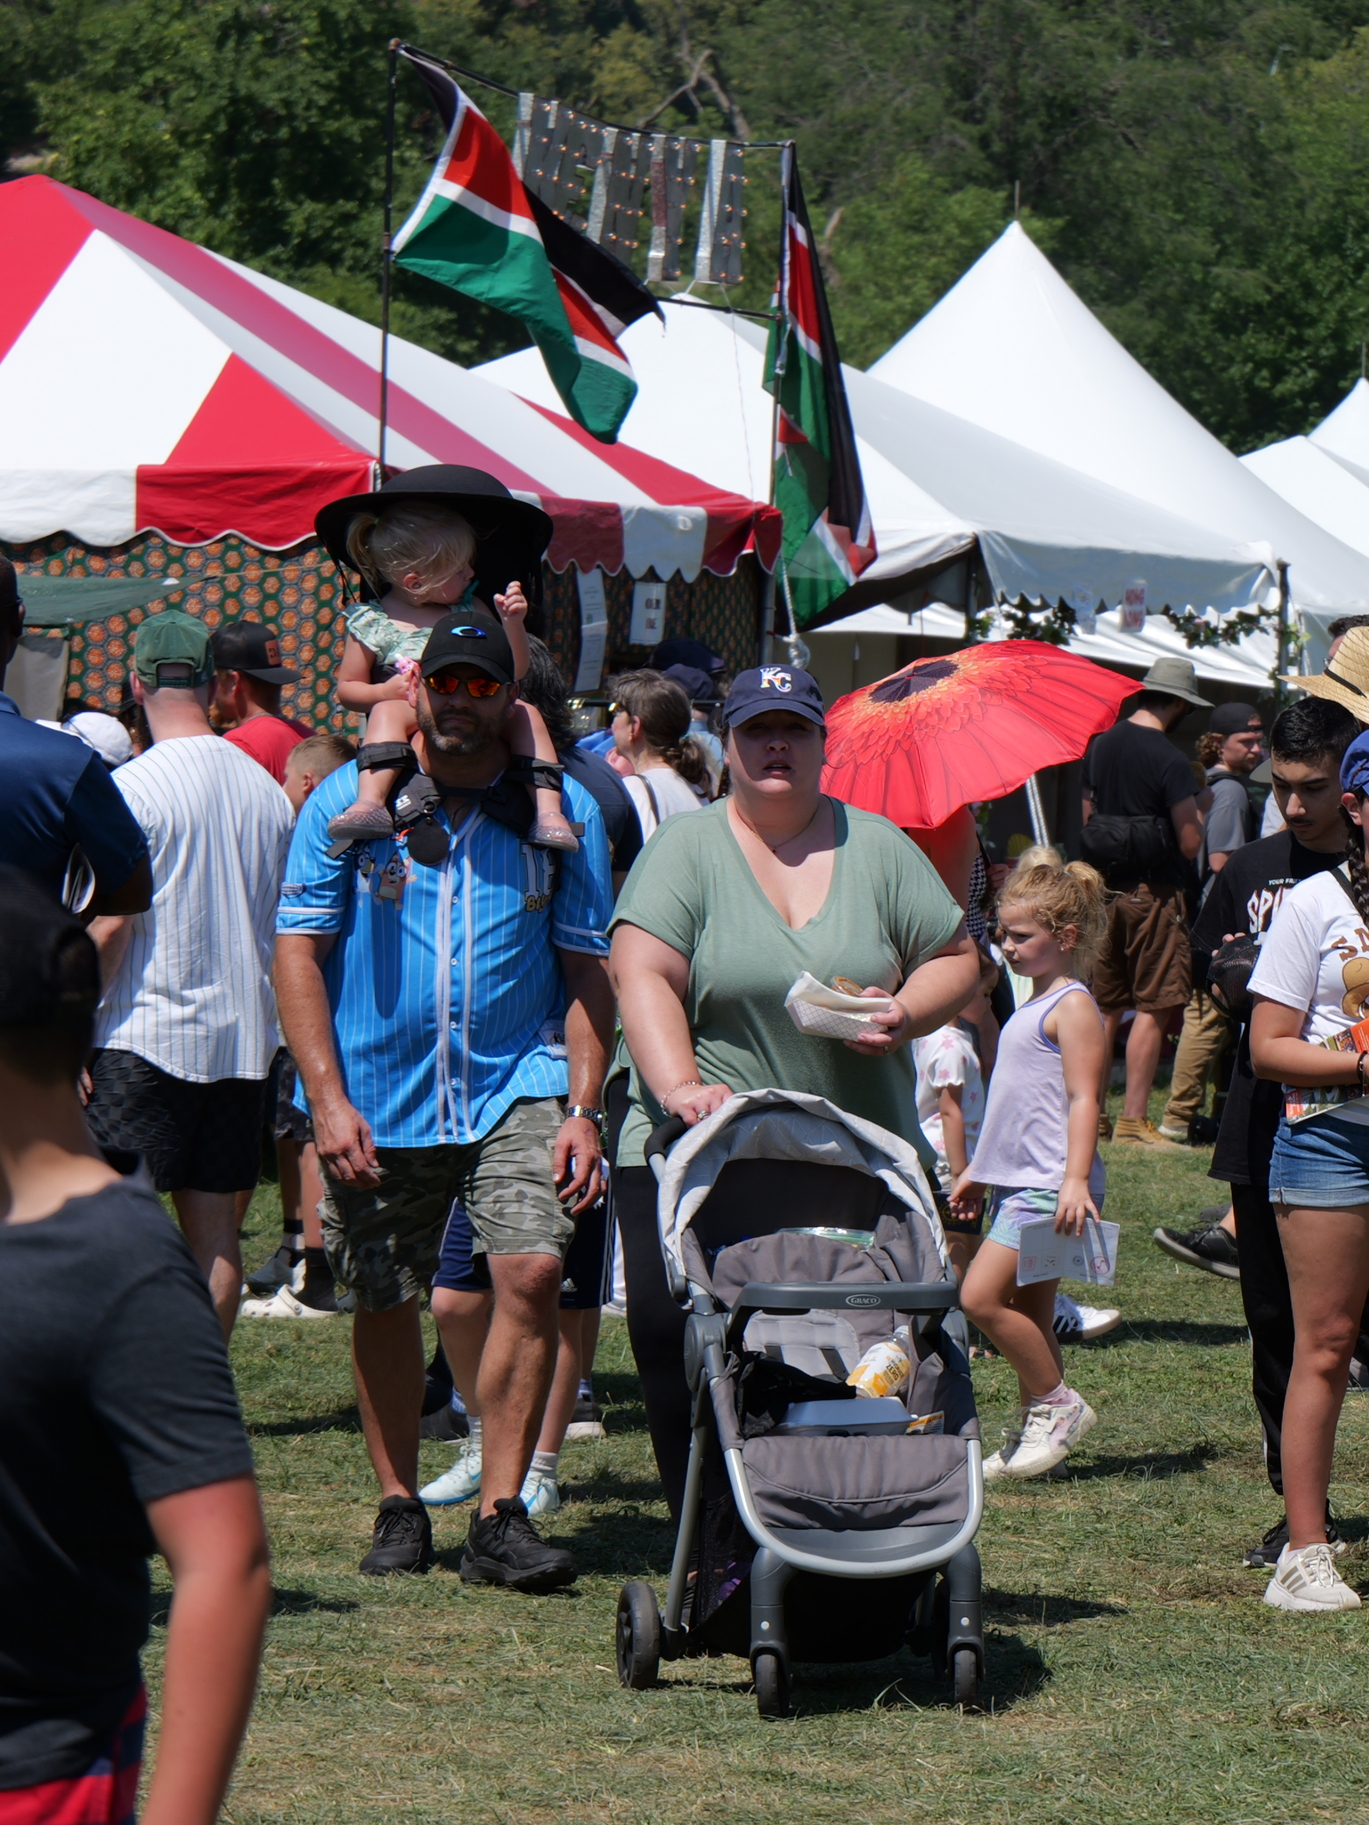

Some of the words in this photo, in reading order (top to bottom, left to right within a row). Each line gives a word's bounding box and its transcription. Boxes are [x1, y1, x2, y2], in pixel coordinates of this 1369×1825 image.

[759, 666, 792, 693] KC
[1268, 878, 1284, 886] YOUR
[850, 1297, 878, 1305] GRACO
[885, 1364, 899, 1381] ZERO
